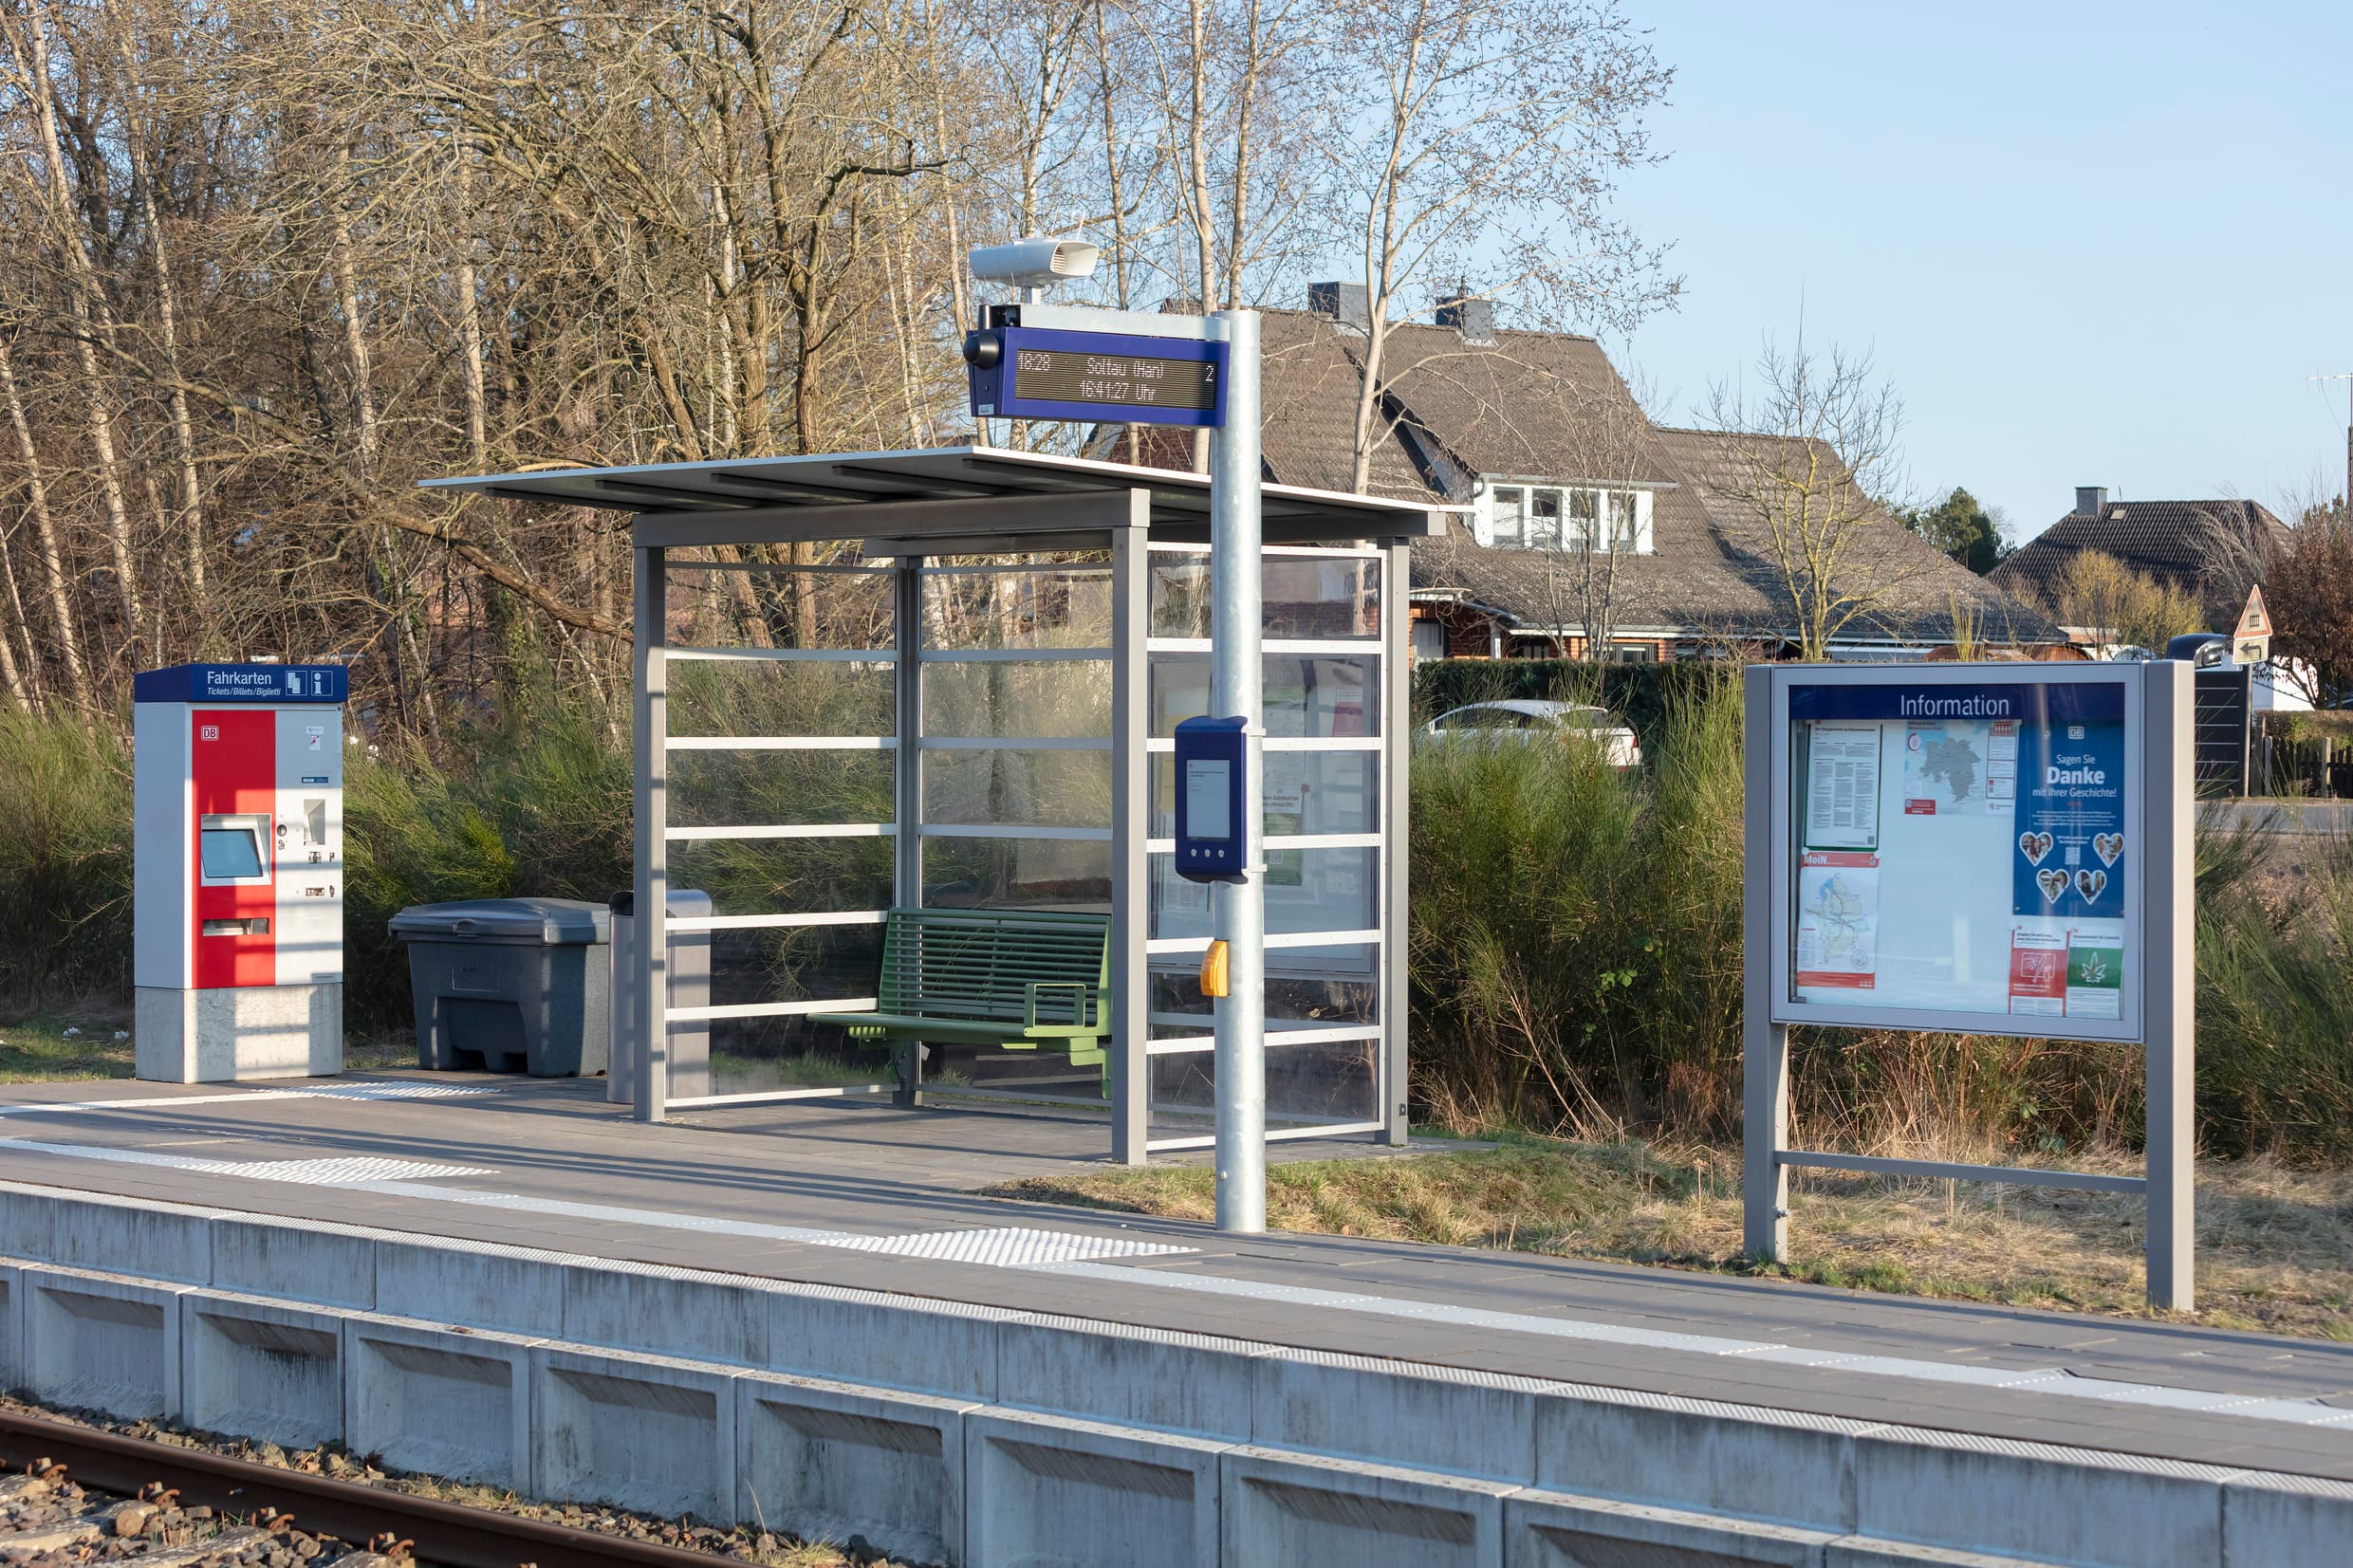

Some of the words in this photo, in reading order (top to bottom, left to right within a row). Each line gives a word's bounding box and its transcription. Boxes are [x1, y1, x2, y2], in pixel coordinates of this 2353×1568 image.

[1017, 353, 1050, 371] 18:28
[1086, 357, 1127, 377] Soltau
[1133, 360, 1164, 378] (Han)
[1205, 365, 1214, 381] 2
[1079, 379, 1129, 398] 16:41:27
[1136, 383, 1156, 400] Uhr
[207, 671, 272, 685] Fahrkarten
[1900, 693, 2010, 715] Information
[203, 728, 217, 738] DB
[2070, 728, 2083, 737] DB
[2056, 753, 2082, 766] Sagen
[2083, 753, 2096, 765] Sie
[2047, 766, 2105, 784] Danke
[2032, 788, 2047, 797] mit
[2048, 788, 2068, 797] Ihrer
[2069, 787, 2117, 798] Geschichte!
